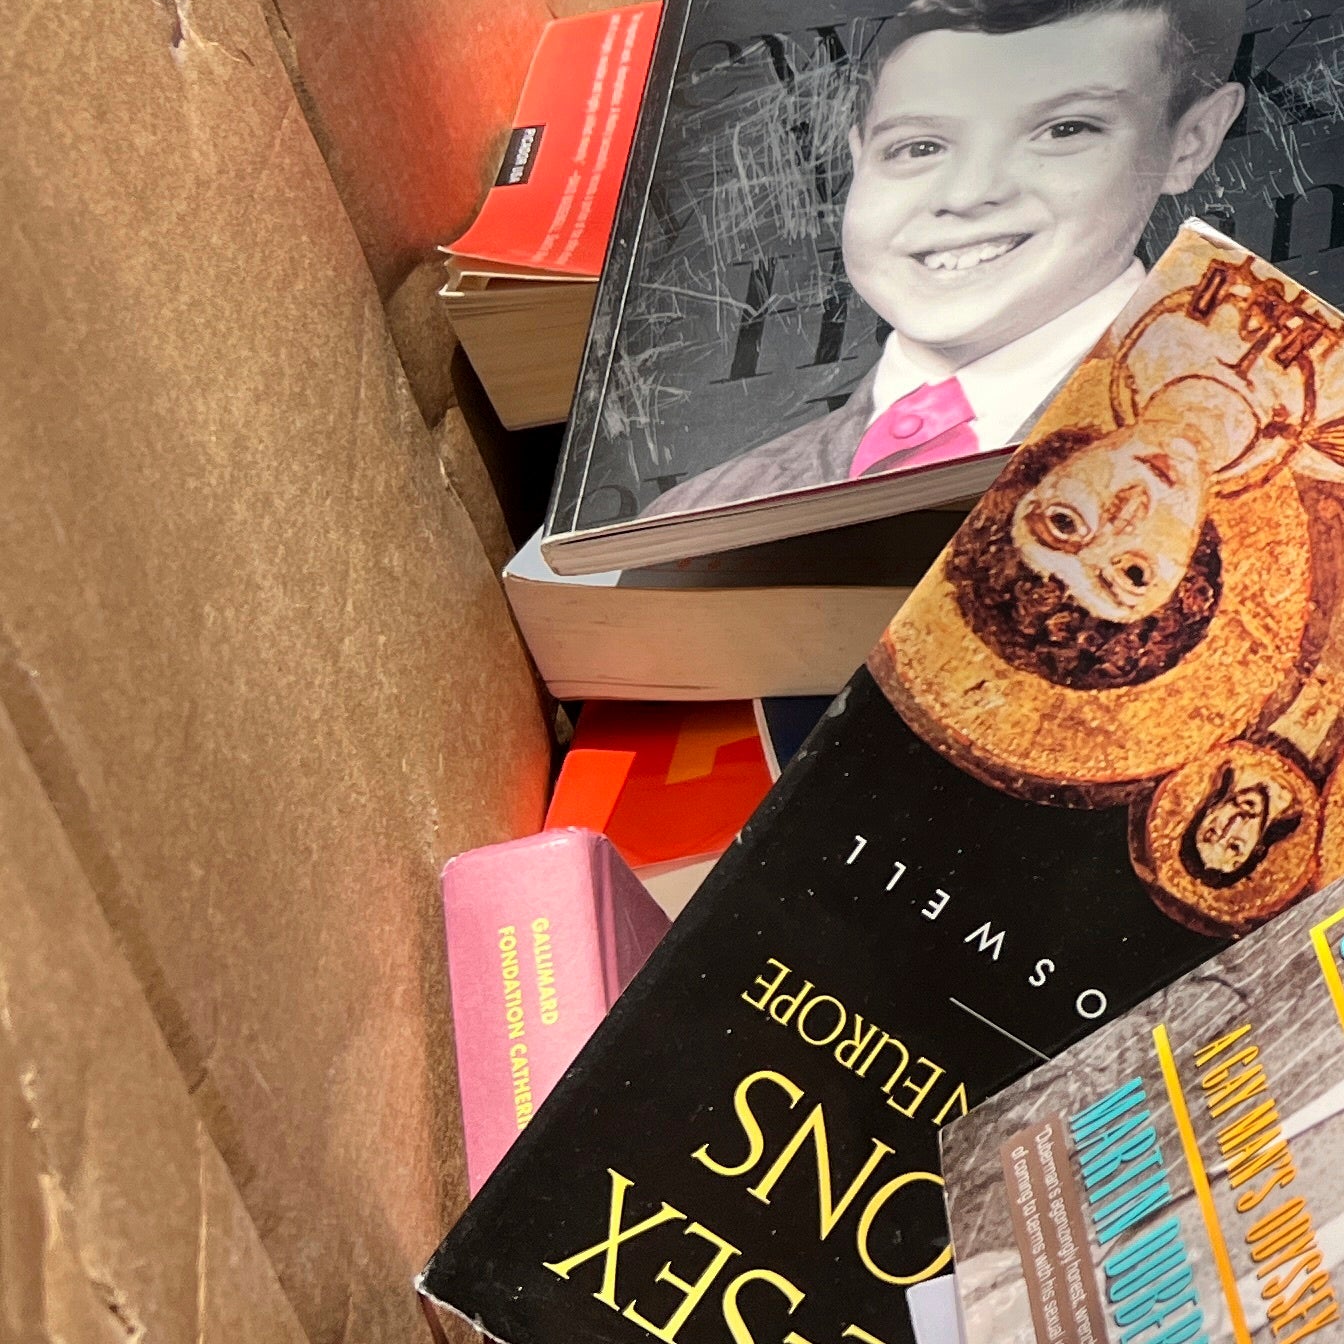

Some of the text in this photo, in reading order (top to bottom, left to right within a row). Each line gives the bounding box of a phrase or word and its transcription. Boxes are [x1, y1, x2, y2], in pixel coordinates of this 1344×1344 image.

[530, 916, 559, 1027] GALLIMARD
[843, 833, 1108, 1020] OSWELL
[498, 925, 534, 1132] FONDATION CATHERI
[740, 956, 946, 1121] EUROPE
[1009, 1143, 1065, 1340] of coming to terms with his sexual
[1067, 1075, 1210, 1344] MARTIN DUBER
[1197, 1044, 1272, 1120] GAY
[1242, 1195, 1342, 1344] ODYSSEY
